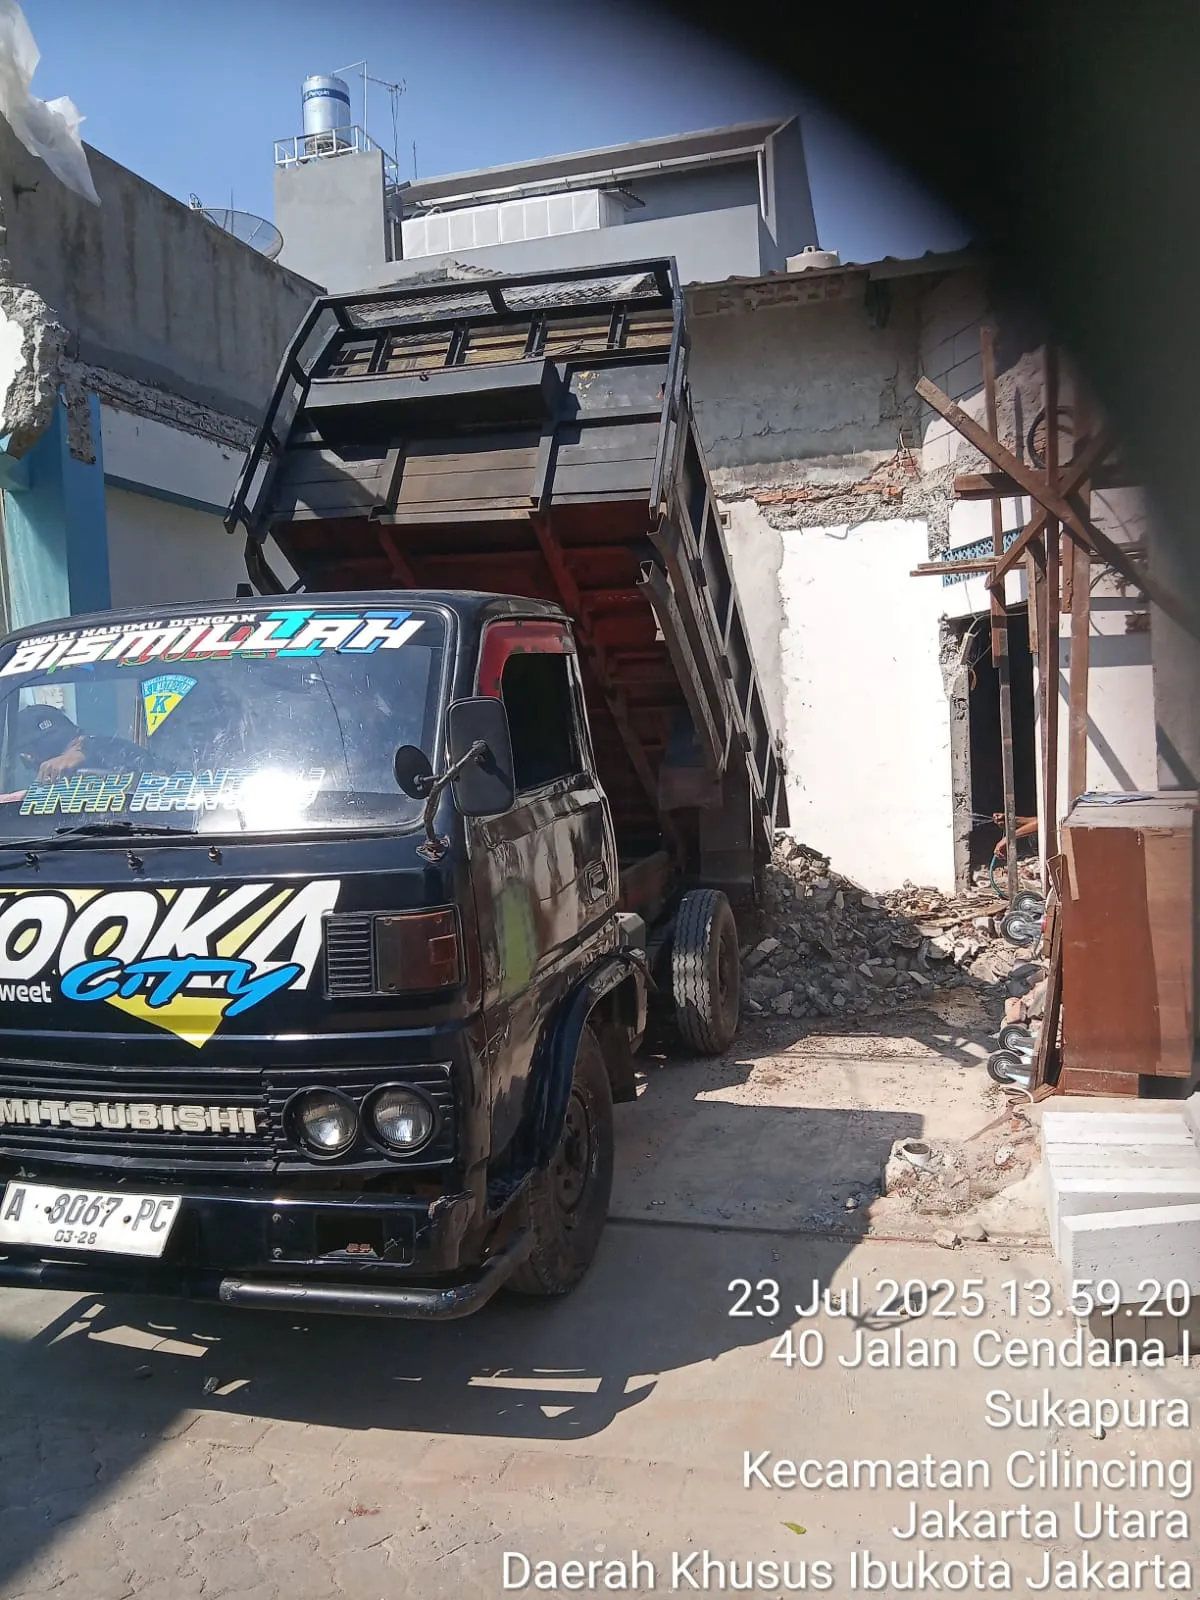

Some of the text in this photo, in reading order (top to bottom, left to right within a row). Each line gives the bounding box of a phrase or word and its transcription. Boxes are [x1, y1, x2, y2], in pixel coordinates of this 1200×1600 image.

[0, 618, 426, 677] BISMILLAH
[17, 614, 257, 649] AWALI HARIMU DENGAN
[150, 695, 172, 713] K
[19, 772, 134, 815] ANAK
[0, 880, 341, 990] OOKA
[0, 1099, 257, 1134] MITSUBISHI
[4, 1188, 175, 1233] A 8067 PC
[54, 1229, 97, 1245] 03-28
